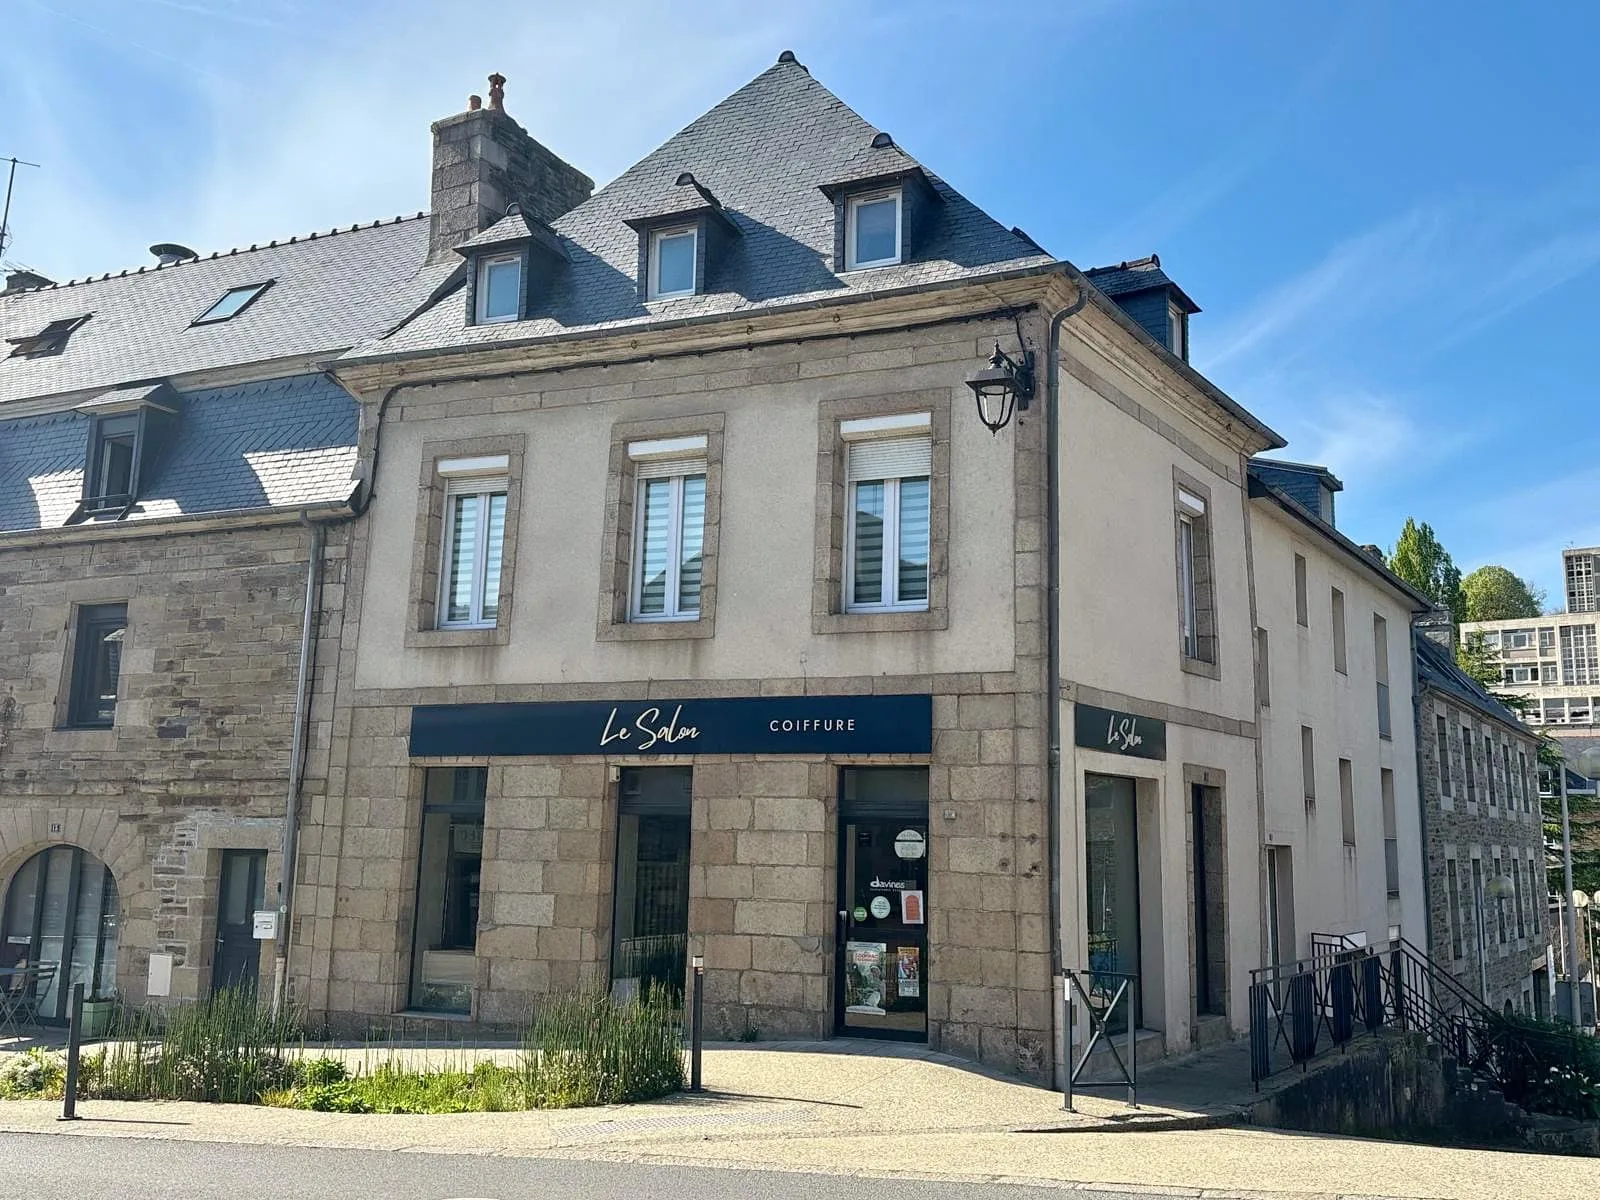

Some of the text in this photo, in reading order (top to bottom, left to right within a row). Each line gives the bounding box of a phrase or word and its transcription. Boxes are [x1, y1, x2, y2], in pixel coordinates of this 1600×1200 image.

[599, 705, 700, 751] Le Salon
[769, 719, 856, 732] COIFFURE
[1107, 714, 1120, 745] Le
